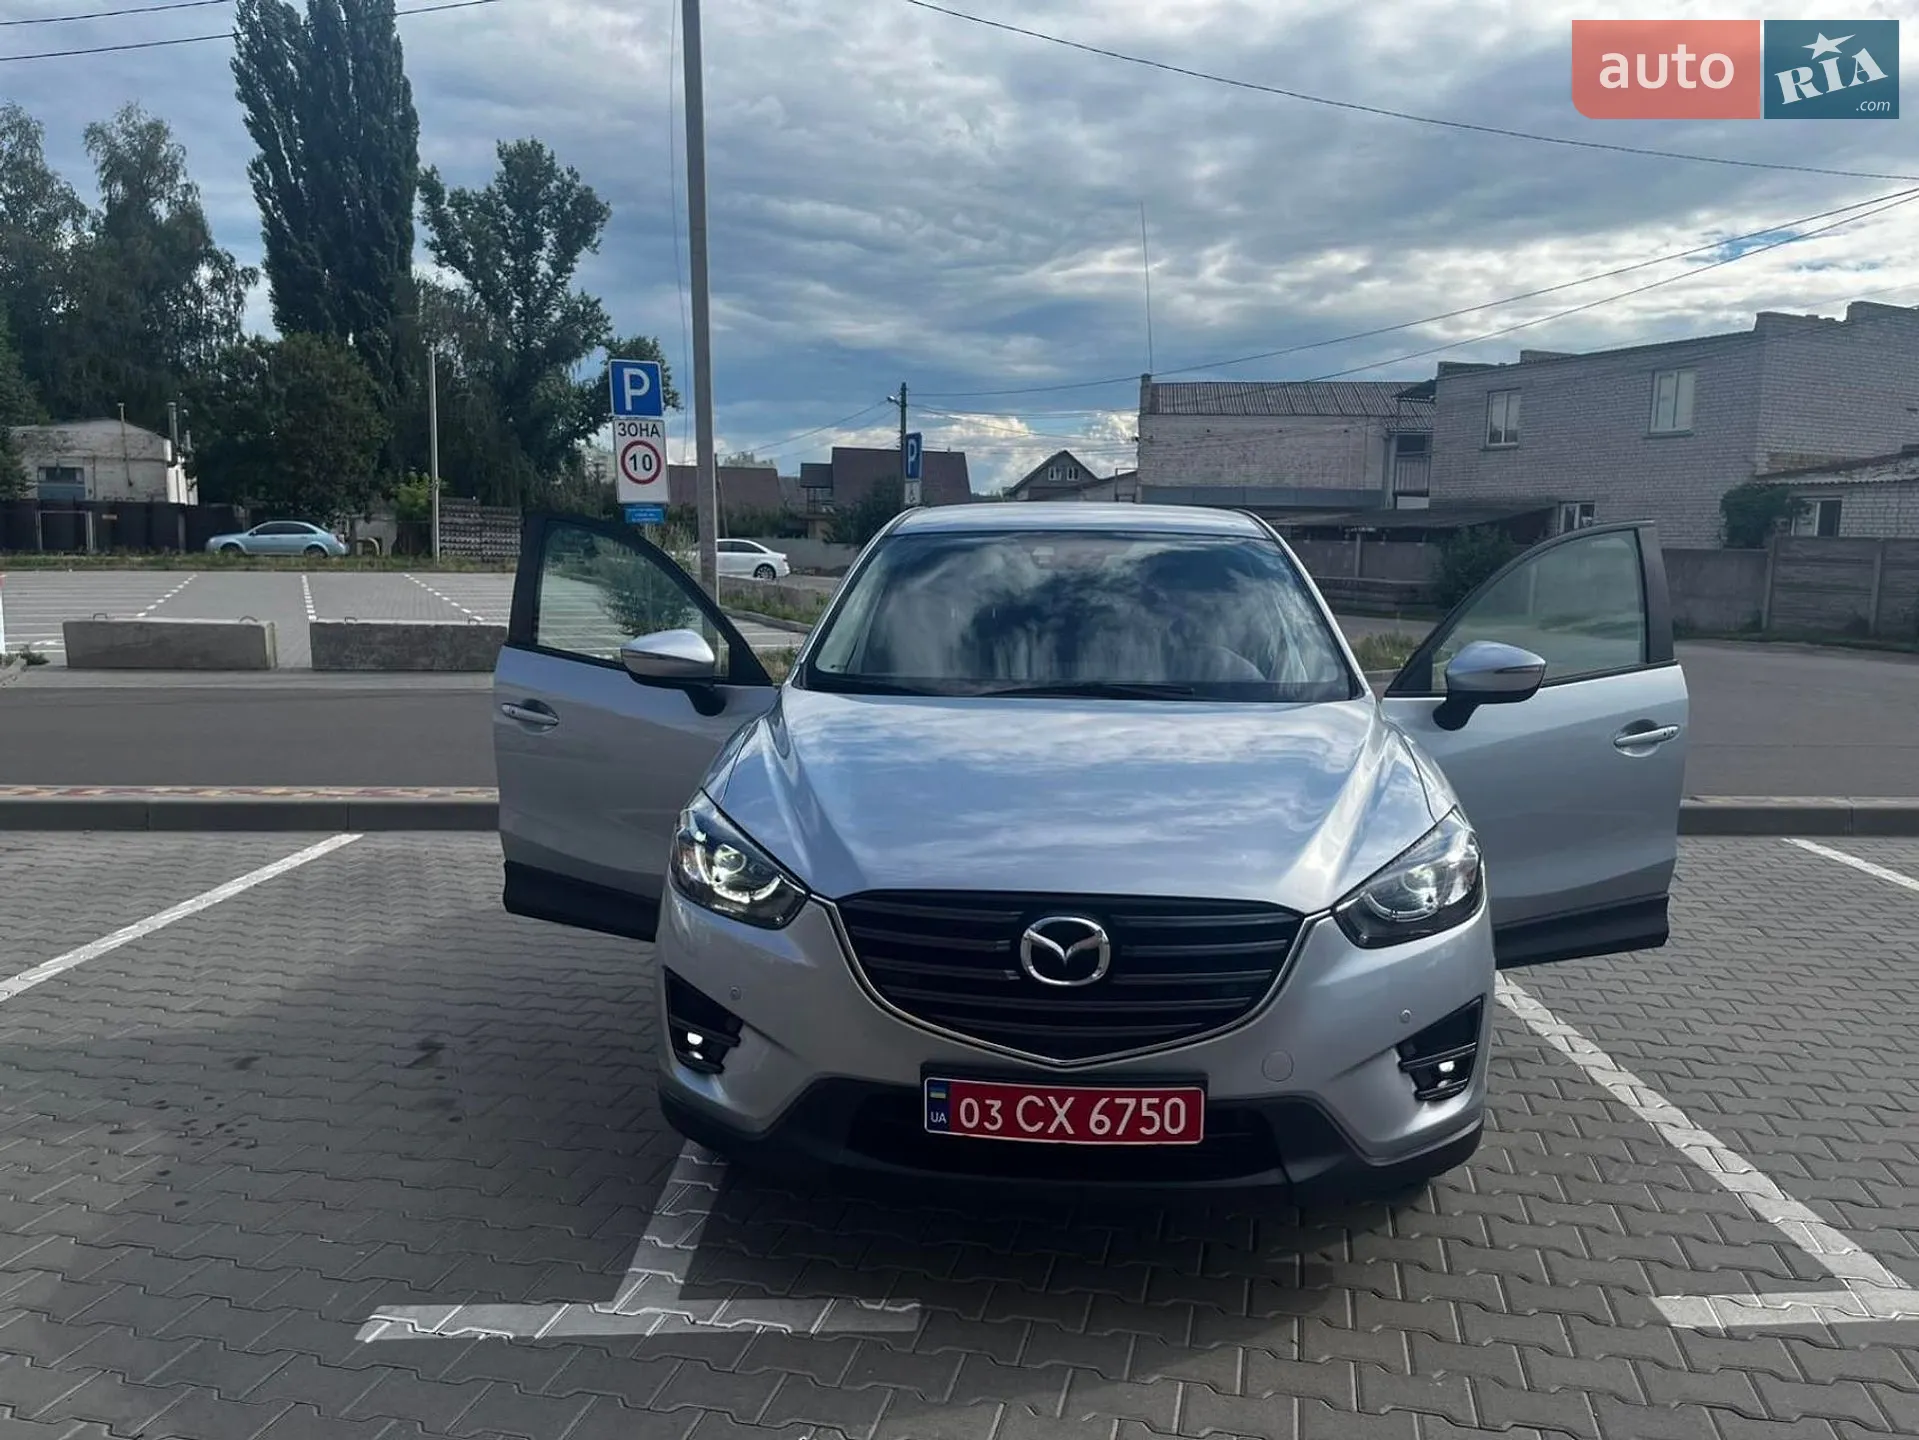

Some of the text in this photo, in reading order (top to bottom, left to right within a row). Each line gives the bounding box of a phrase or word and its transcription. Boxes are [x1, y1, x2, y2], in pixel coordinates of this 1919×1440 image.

[623, 367, 650, 411] P
[617, 422, 660, 438] ЗОНА
[628, 453, 653, 472] 10
[907, 438, 917, 475] P
[930, 1112, 947, 1124] UA
[959, 1095, 1187, 1136] 03 CX 6750
